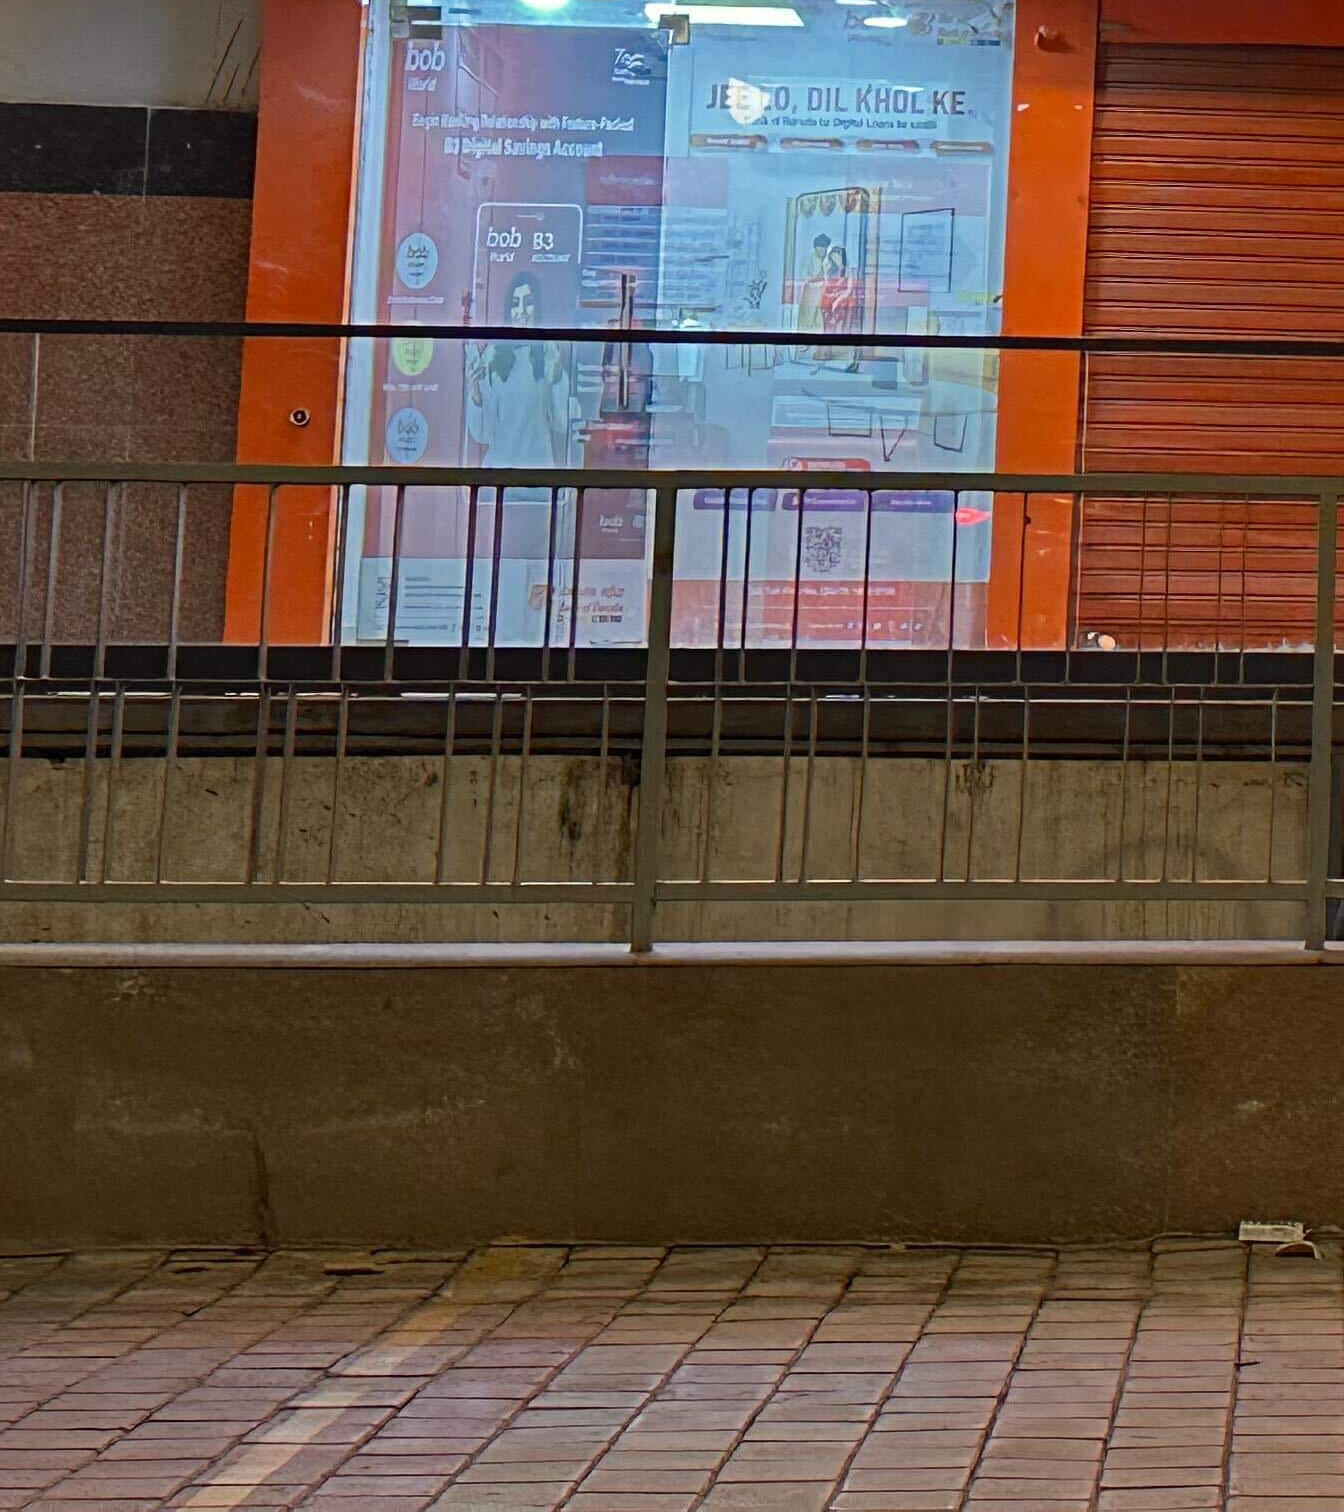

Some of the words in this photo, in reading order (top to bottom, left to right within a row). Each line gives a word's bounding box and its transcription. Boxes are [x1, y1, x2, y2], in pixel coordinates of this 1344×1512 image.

[404, 40, 446, 72] bob
[807, 87, 849, 113] DIL
[856, 86, 924, 115] KHOL
[487, 225, 522, 249] bob
